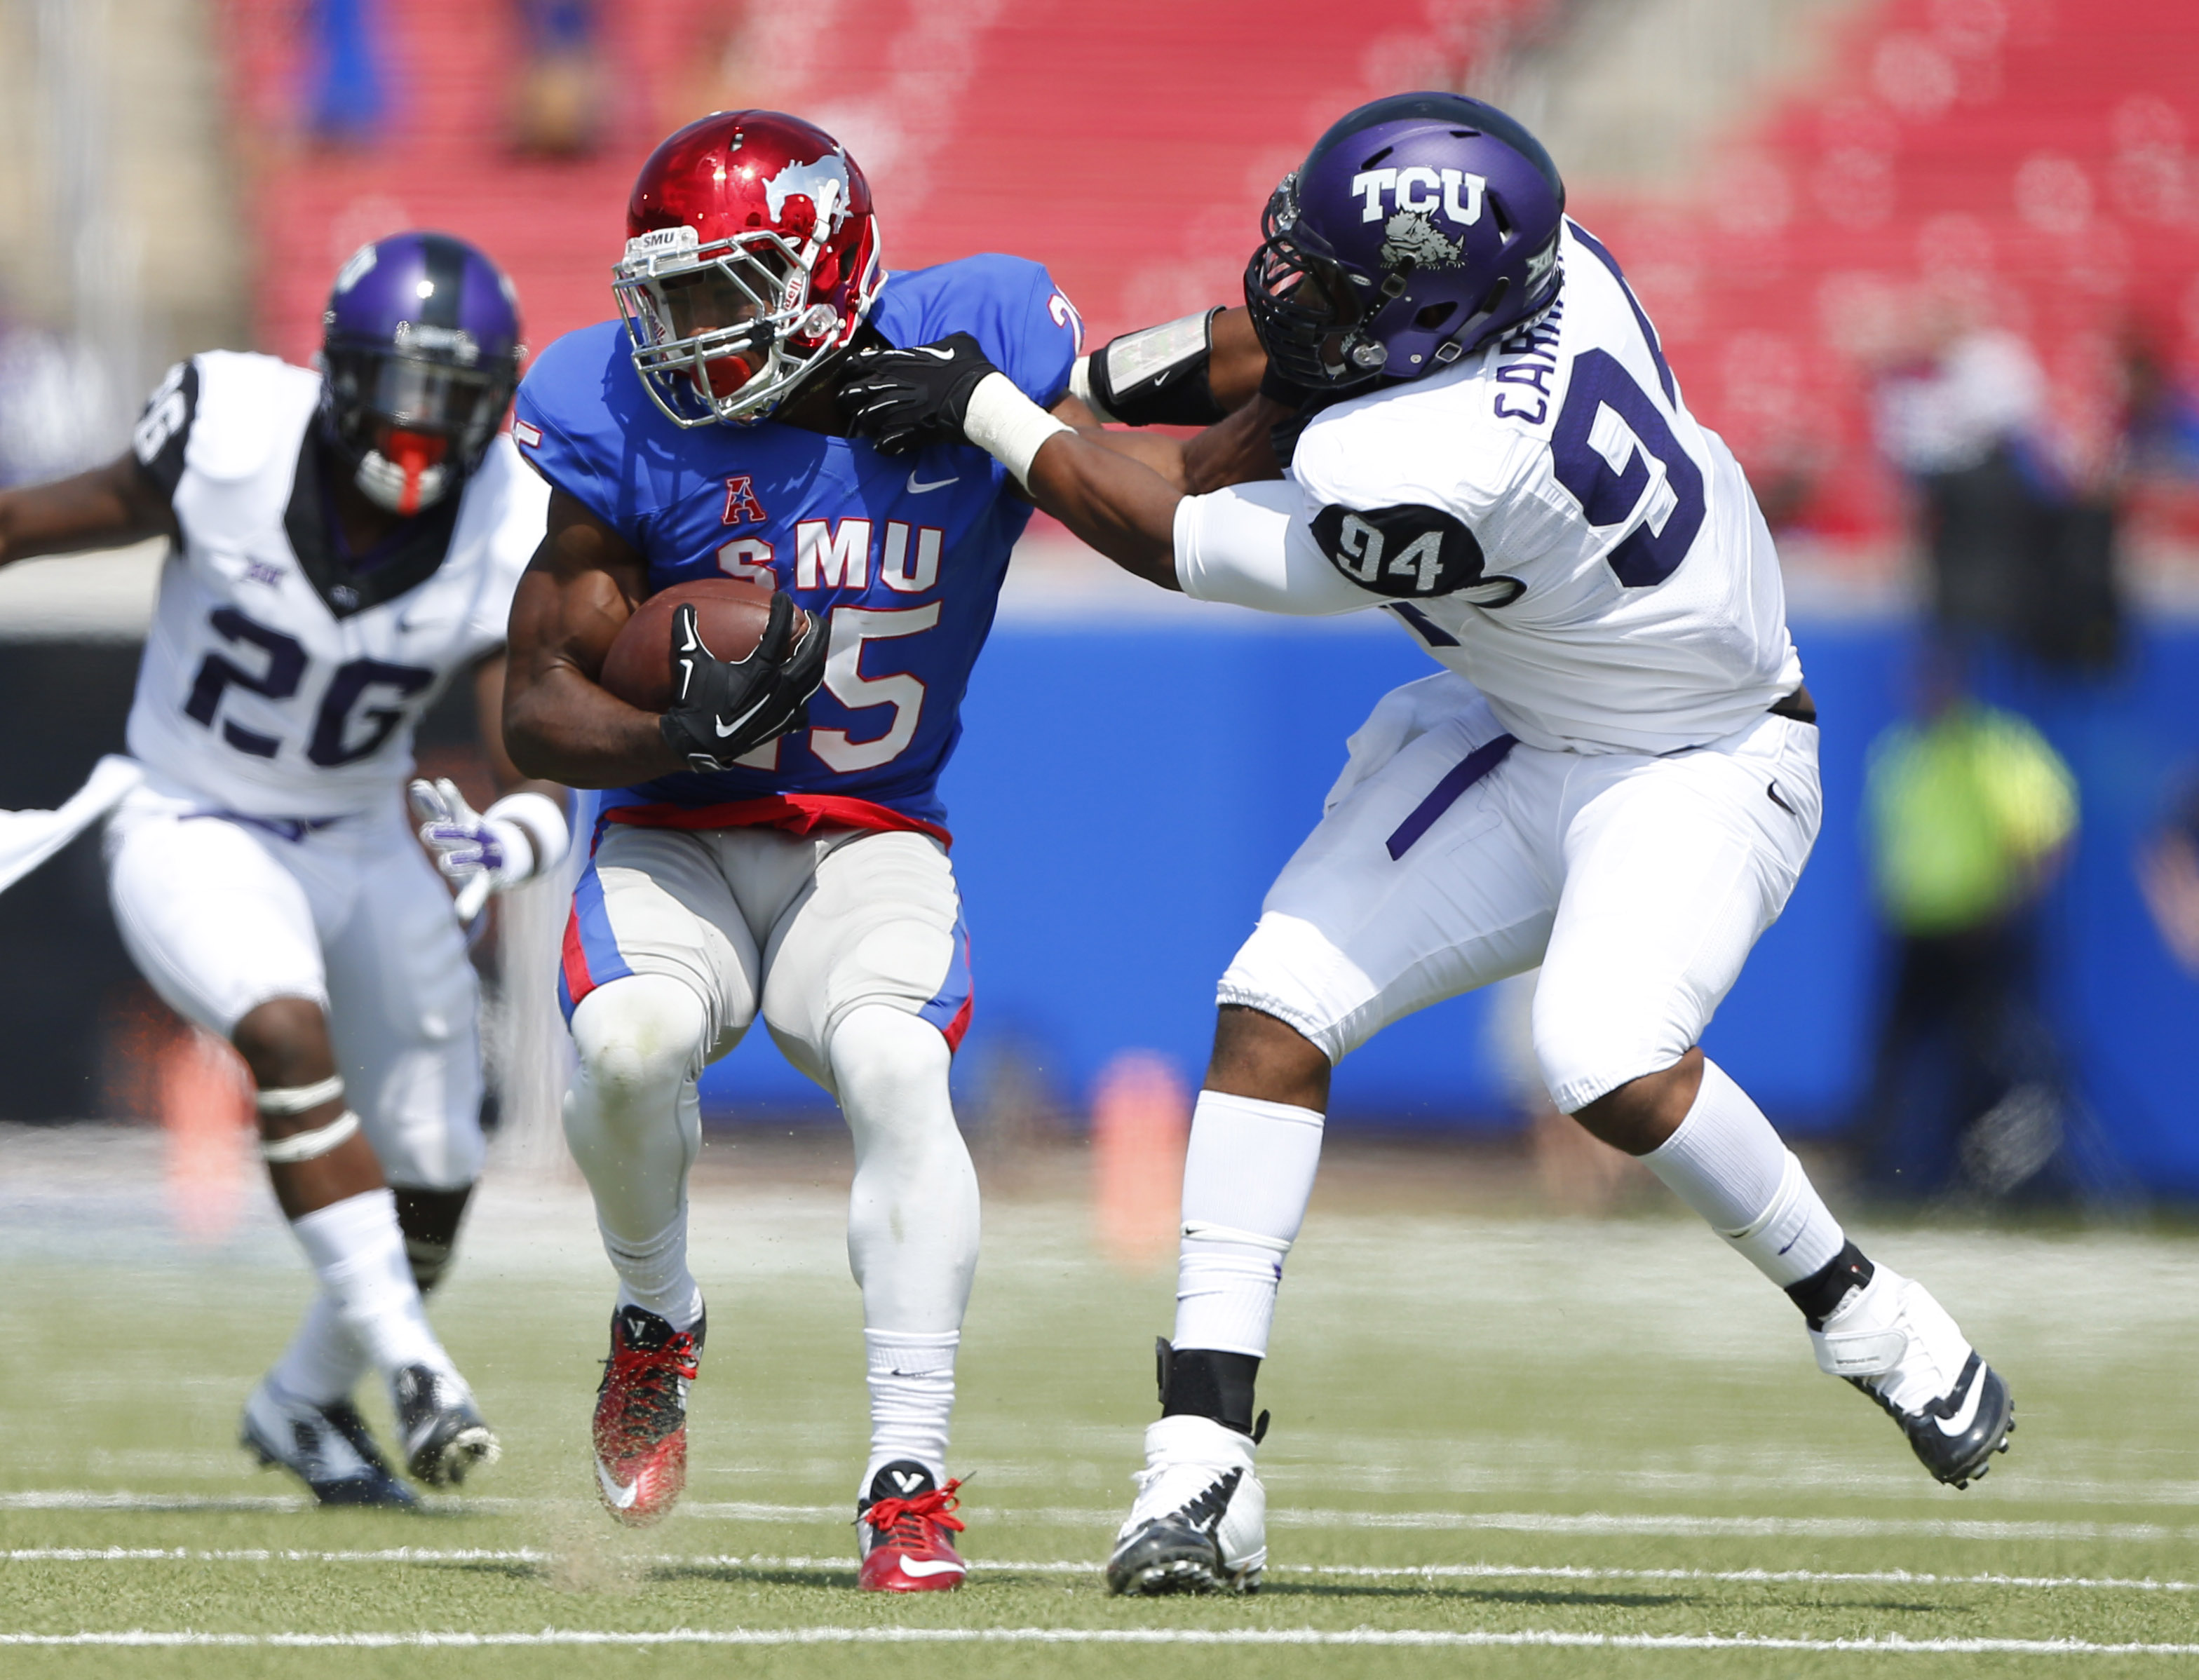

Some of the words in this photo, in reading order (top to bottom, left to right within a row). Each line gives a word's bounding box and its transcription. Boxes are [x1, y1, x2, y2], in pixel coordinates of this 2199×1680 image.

[1352, 167, 1487, 226] TCU
[643, 232, 675, 246] SMU
[717, 517, 944, 593] SMU
[1336, 513, 1444, 591] 94
[182, 604, 435, 767] 26
